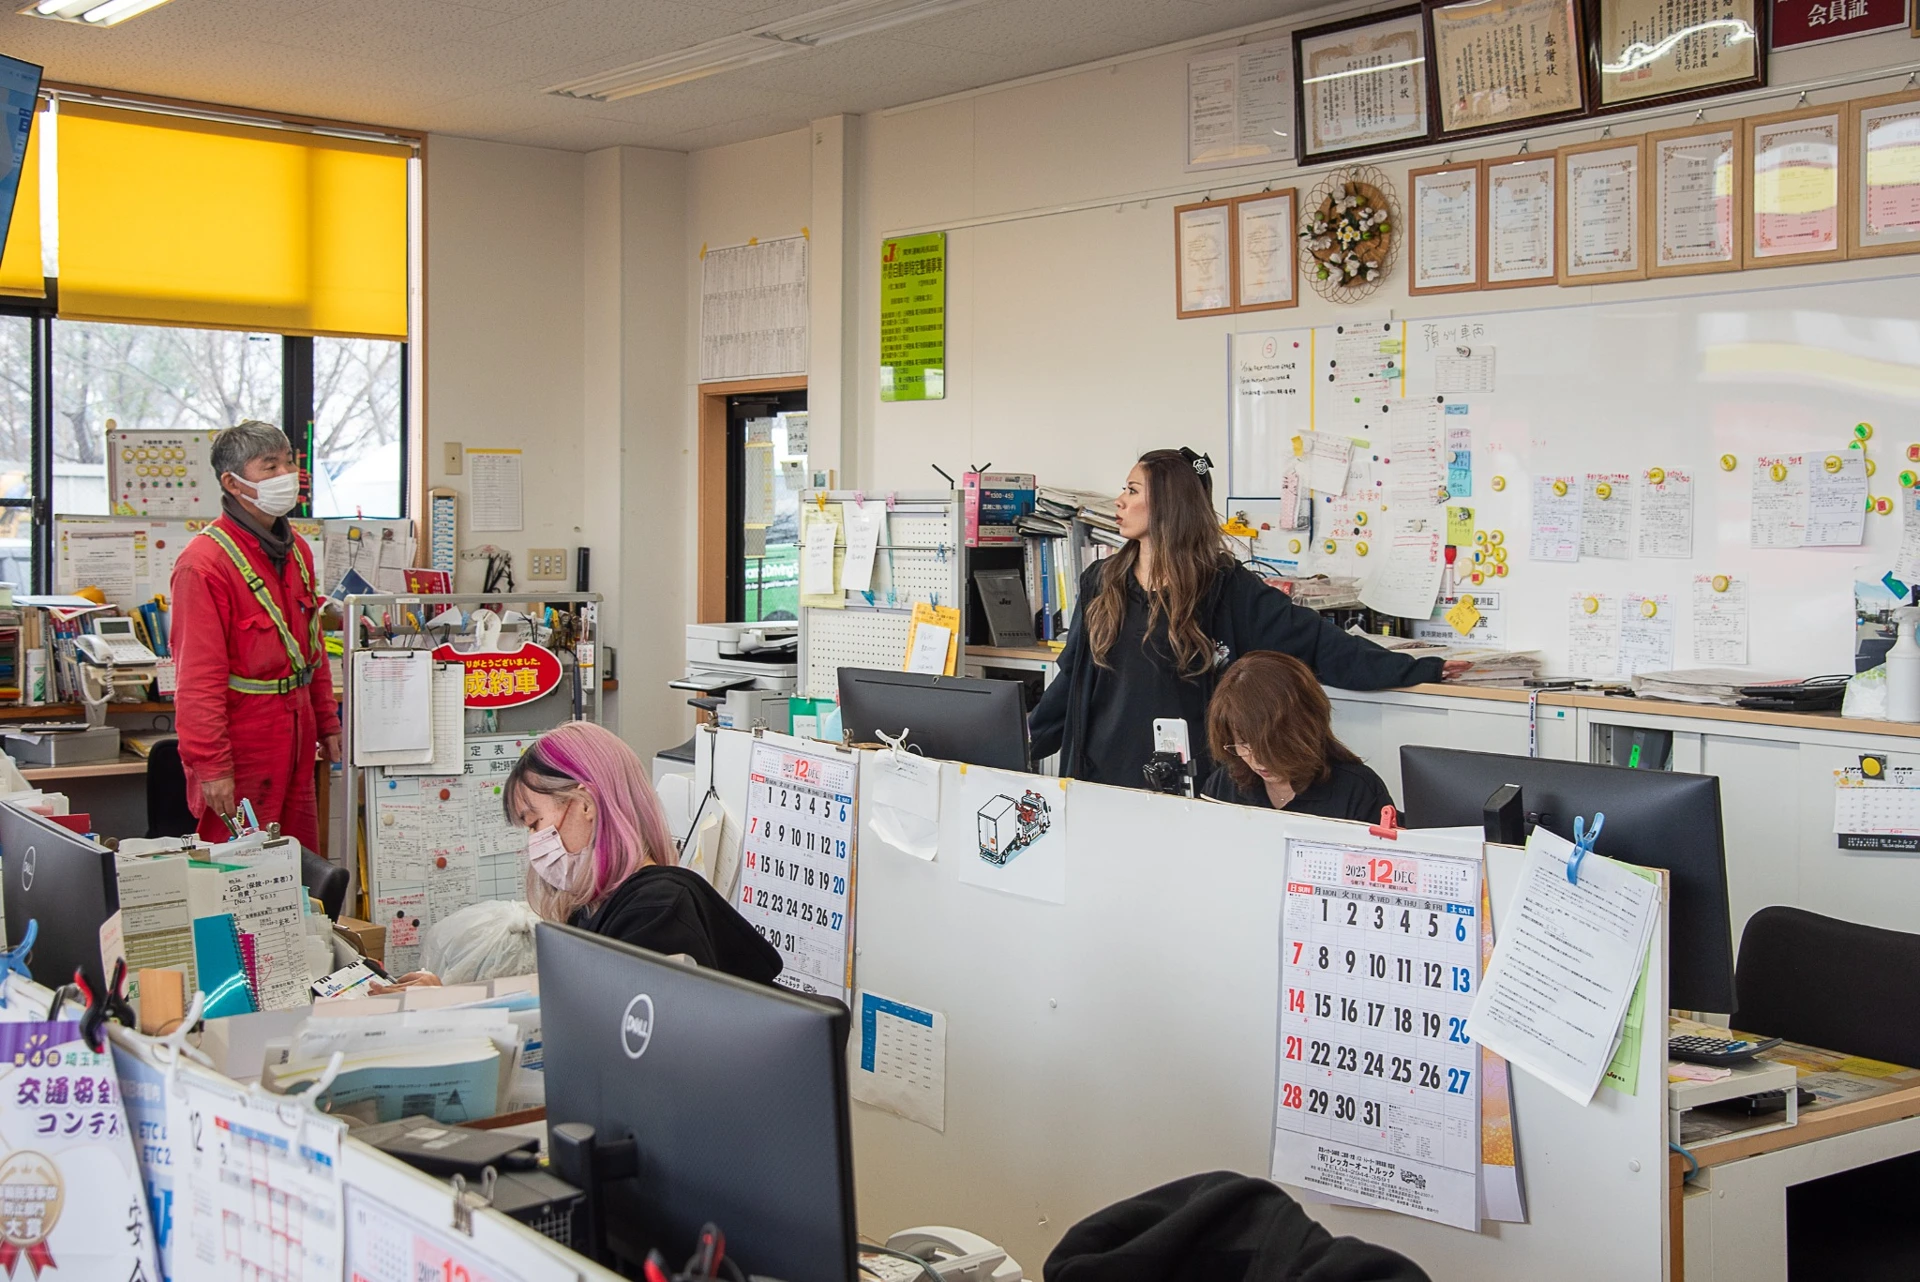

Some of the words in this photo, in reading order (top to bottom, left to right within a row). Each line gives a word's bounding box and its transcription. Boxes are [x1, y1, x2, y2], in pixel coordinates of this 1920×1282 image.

[1808, 0, 1868, 27] 会員証
[1544, 31, 1558, 76] 感謝状
[466, 658, 540, 668] りがとうございました。
[465, 668, 538, 697] 成約車
[795, 759, 808, 778] 12
[769, 787, 771, 803] 1
[781, 790, 786, 806] 2
[795, 794, 800, 810] 3
[810, 798, 815, 814] 4
[825, 801, 830, 818] 5
[840, 805, 846, 822] 6
[751, 818, 757, 833] 7
[765, 822, 770, 838] 8
[779, 825, 784, 841] 9
[792, 828, 801, 846] 10
[807, 832, 814, 850] 11
[821, 836, 830, 854] 12
[836, 840, 845, 858] 13
[747, 852, 755, 869] 14
[761, 855, 770, 873] 15
[776, 859, 784, 877] 16
[790, 864, 799, 881] 17
[805, 868, 814, 886] 18
[820, 872, 829, 890] 19
[833, 876, 844, 895] 20
[1346, 864, 1366, 878] 2025
[1368, 858, 1392, 884] 12
[1394, 870, 1416, 884] DEC.
[743, 886, 752, 903] 21
[757, 890, 768, 908] 22
[772, 894, 783, 913] 23
[787, 899, 797, 917] 24
[802, 903, 812, 921] 25
[817, 908, 827, 926] 26
[831, 912, 843, 930] 27
[1298, 886, 1311, 894] SUN
[1314, 887, 1322, 896] 月
[1342, 891, 1349, 899] 火
[1368, 894, 1376, 902] 水
[1395, 897, 1402, 906] 木
[1404, 900, 1417, 908] THU
[1424, 901, 1432, 910] 金
[1322, 899, 1327, 921] 1
[1347, 902, 1356, 925] 2
[1374, 906, 1383, 929] 3
[1401, 910, 1410, 933] 4
[1429, 913, 1437, 937] 5
[1456, 918, 1466, 941] 6
[769, 929, 781, 948] 30
[785, 934, 794, 952] 31
[1293, 943, 1302, 964] 7
[1319, 946, 1328, 969] 8
[1346, 951, 1355, 973] 9
[1370, 954, 1385, 978] 10
[1398, 958, 1410, 983] 11
[1424, 962, 1441, 988] 12
[1452, 967, 1470, 992] 13
[1290, 989, 1304, 1013] 14
[1315, 993, 1330, 1017] 15
[1341, 998, 1357, 1022] 16
[1368, 1003, 1384, 1027] 17
[1395, 1007, 1412, 1032] 18
[1423, 1012, 1440, 1037] 19
[1286, 1036, 1301, 1060] 21
[1311, 1041, 1330, 1066] 22
[1337, 1046, 1356, 1071] 23
[1364, 1051, 1383, 1077] 24
[1391, 1057, 1411, 1082] 25
[1419, 1063, 1440, 1089] 26
[1448, 1068, 1470, 1094] 27
[17, 1076, 118, 1105] 交通安全
[1283, 1084, 1302, 1109] 28
[1309, 1089, 1328, 1114] 29
[1335, 1095, 1355, 1121] 30
[1363, 1101, 1380, 1127] 31
[38, 1112, 122, 1135] コンテス
[190, 1110, 204, 1152] 12
